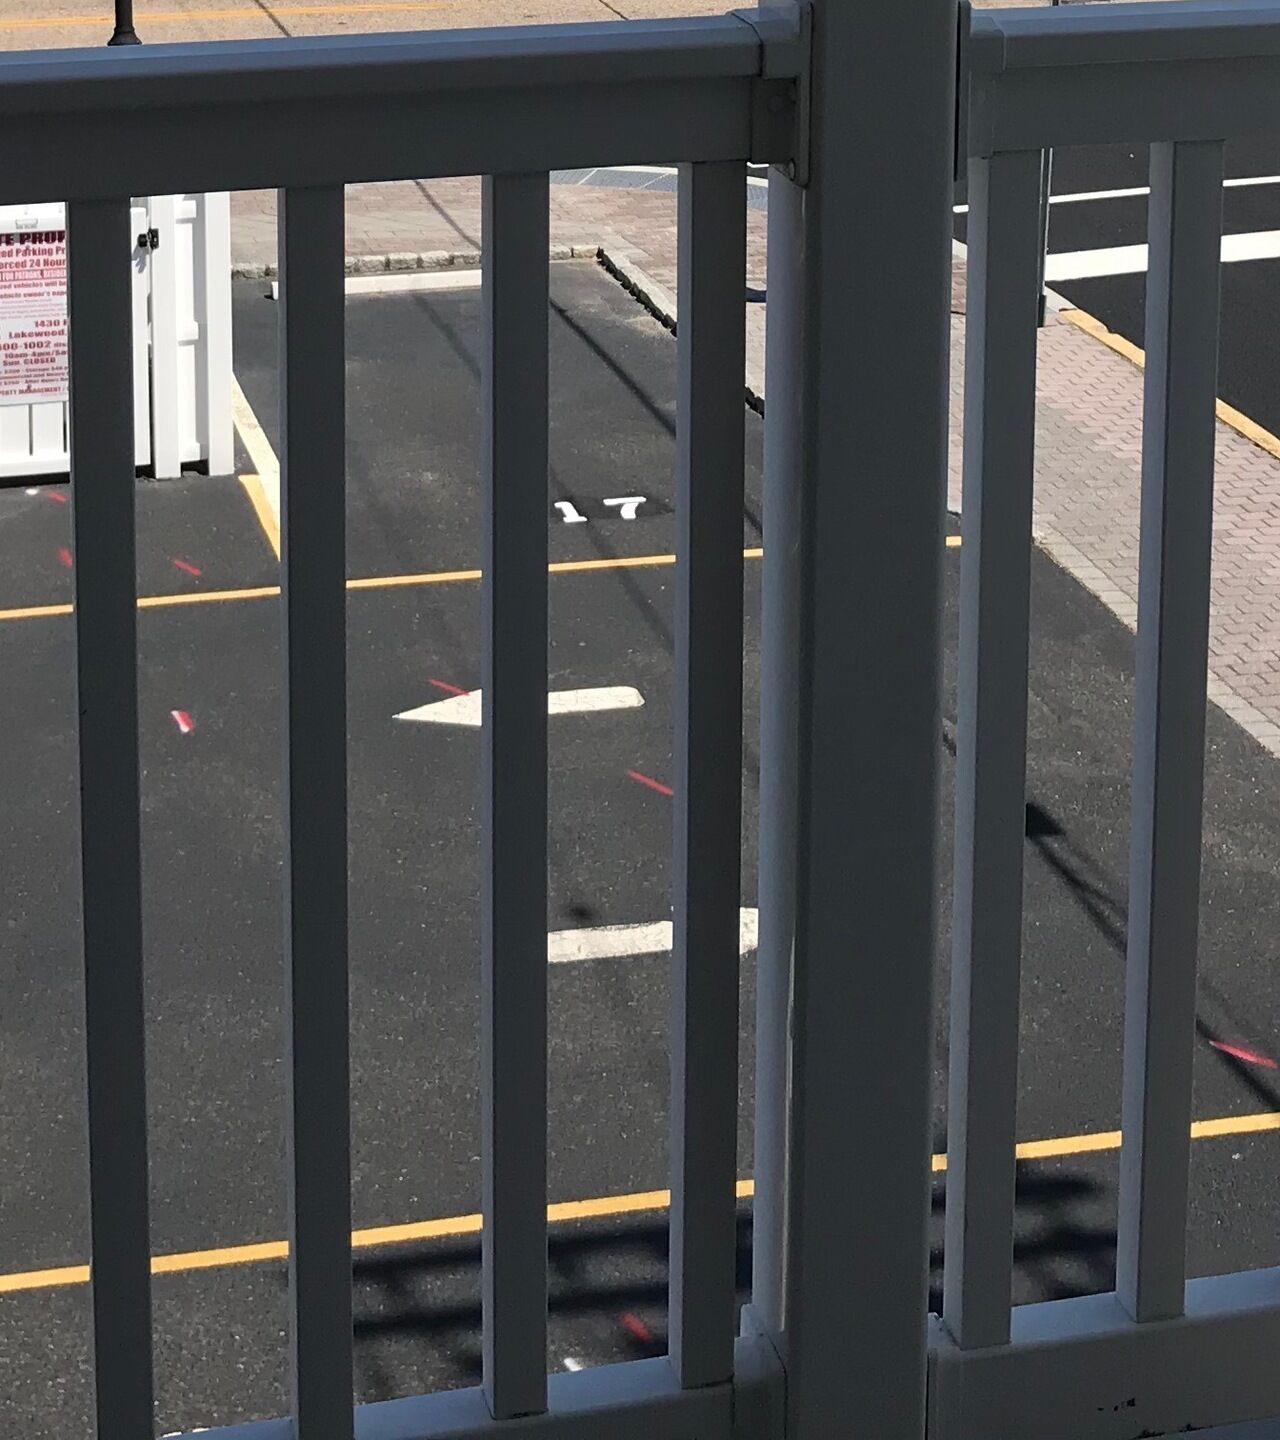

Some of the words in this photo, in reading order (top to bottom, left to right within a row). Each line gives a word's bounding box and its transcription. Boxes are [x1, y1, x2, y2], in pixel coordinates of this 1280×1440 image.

[16, 246, 54, 258] Parking
[29, 259, 41, 268] 24
[554, 496, 647, 523] 17
